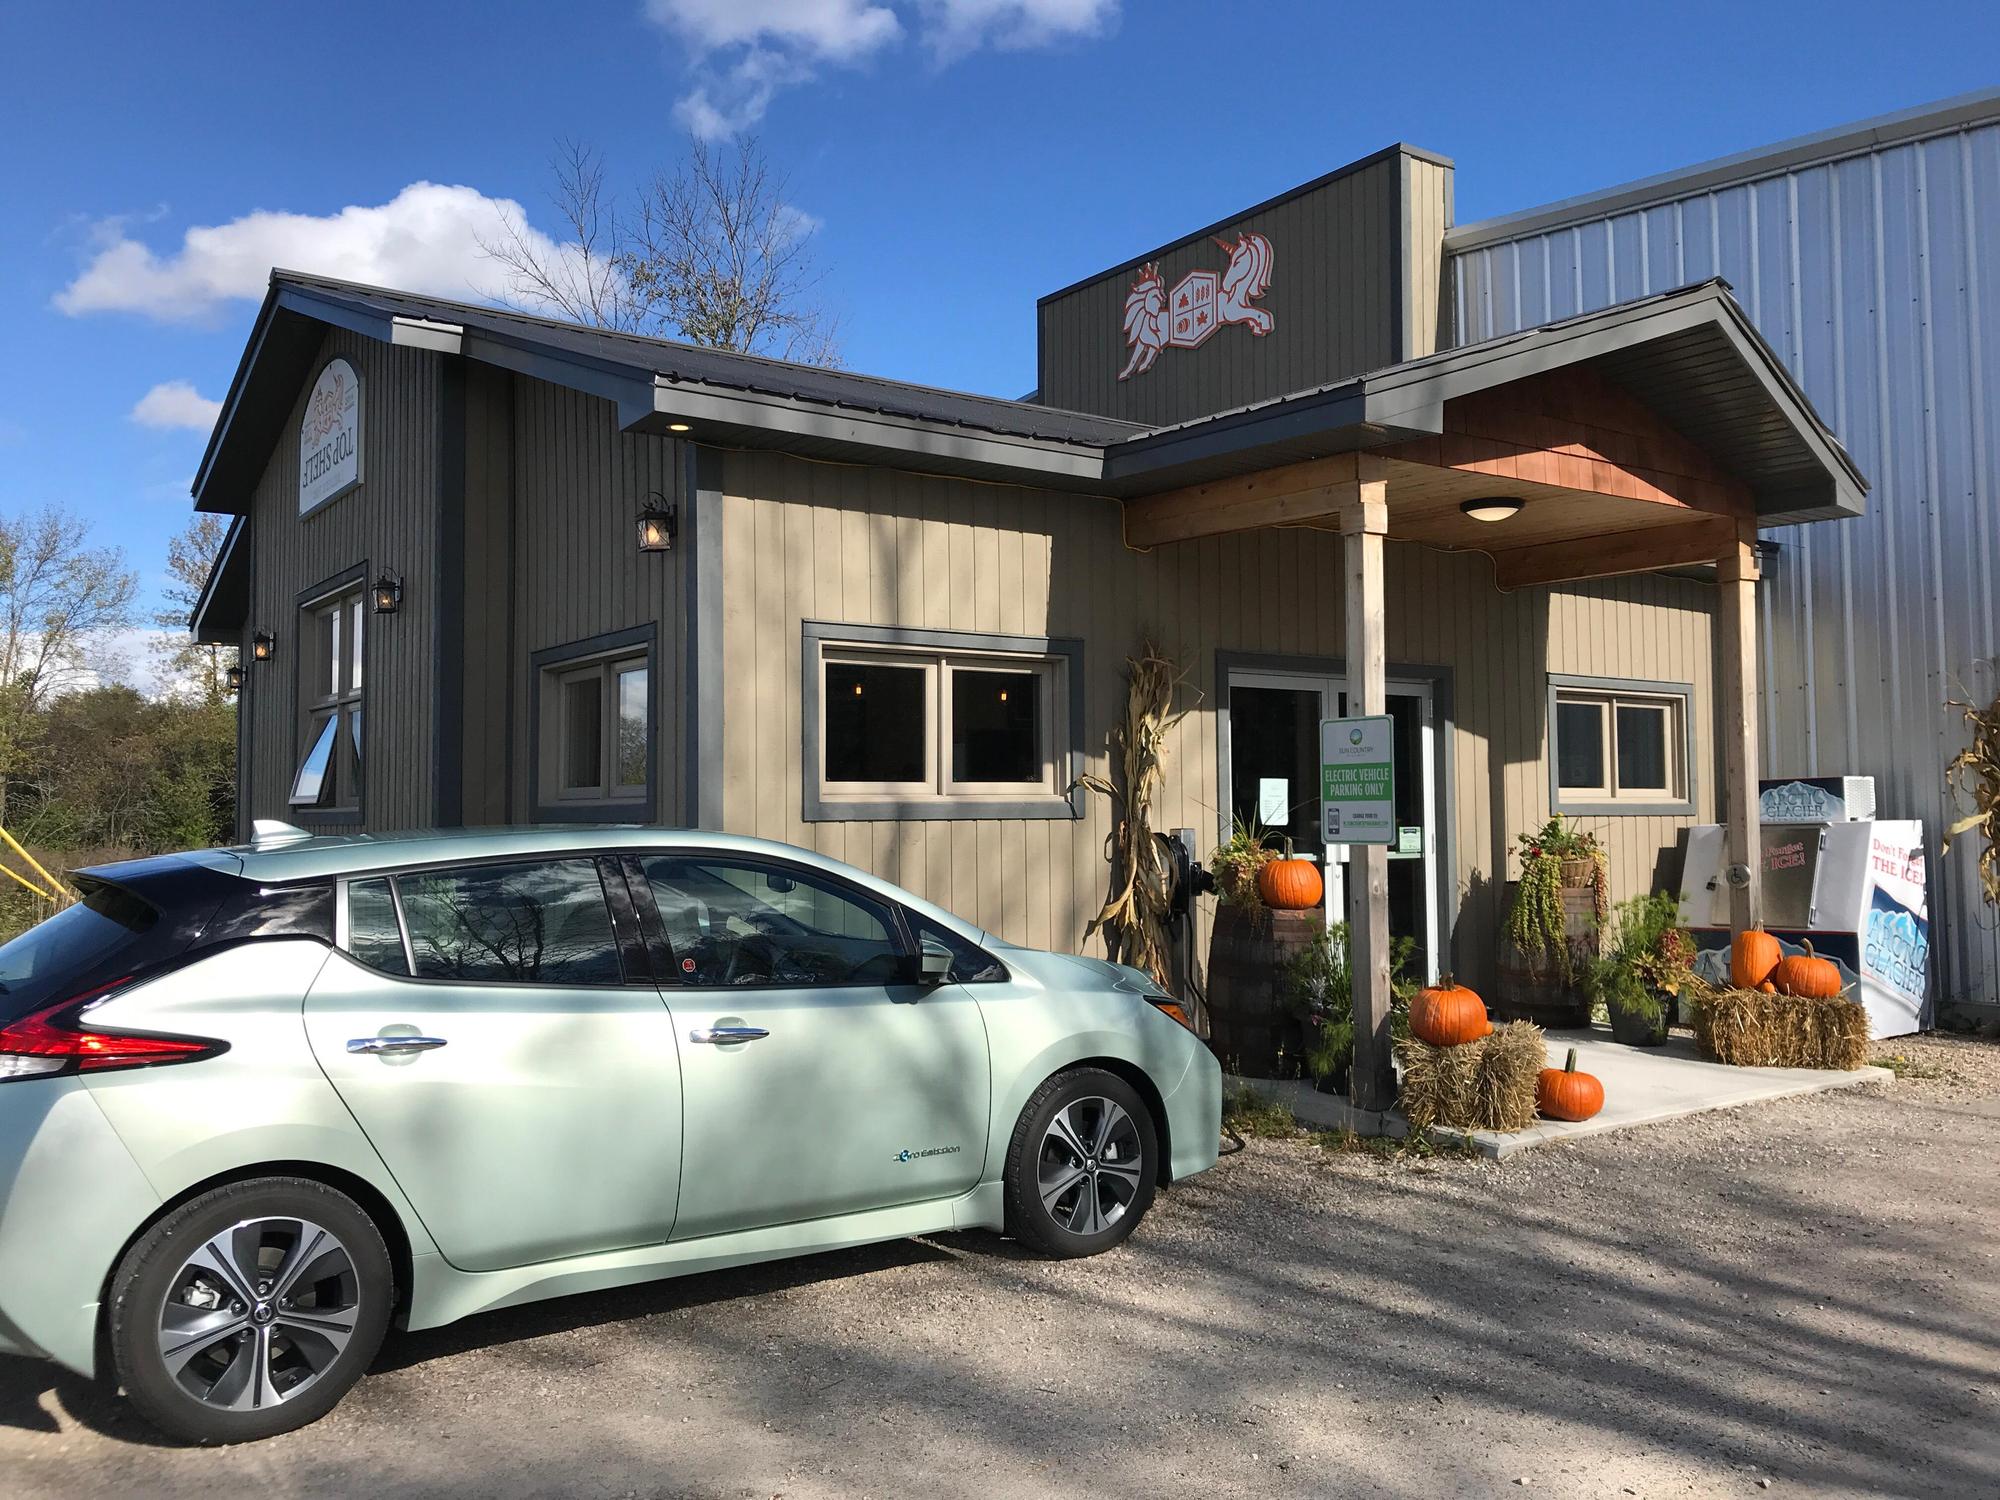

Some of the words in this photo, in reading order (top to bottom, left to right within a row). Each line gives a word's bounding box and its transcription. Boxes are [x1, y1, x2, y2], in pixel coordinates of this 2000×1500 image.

[334, 427, 354, 466] TOP
[303, 444, 332, 489] SHELF
[1325, 768, 1358, 782] ELECTRIC
[1359, 767, 1389, 781] VEHICLE
[1330, 783, 1363, 797] PARKING
[1365, 783, 1384, 796] ONLY
[1766, 789, 1825, 806] ARCTIC
[1766, 804, 1825, 818] GLACIER
[1873, 838, 1896, 857] Don't
[1872, 855, 1898, 877] THE
[1901, 865, 1923, 887] ICE!
[1867, 913, 1927, 975] ARCTIC
[1865, 943, 1923, 1000] GLACIER
